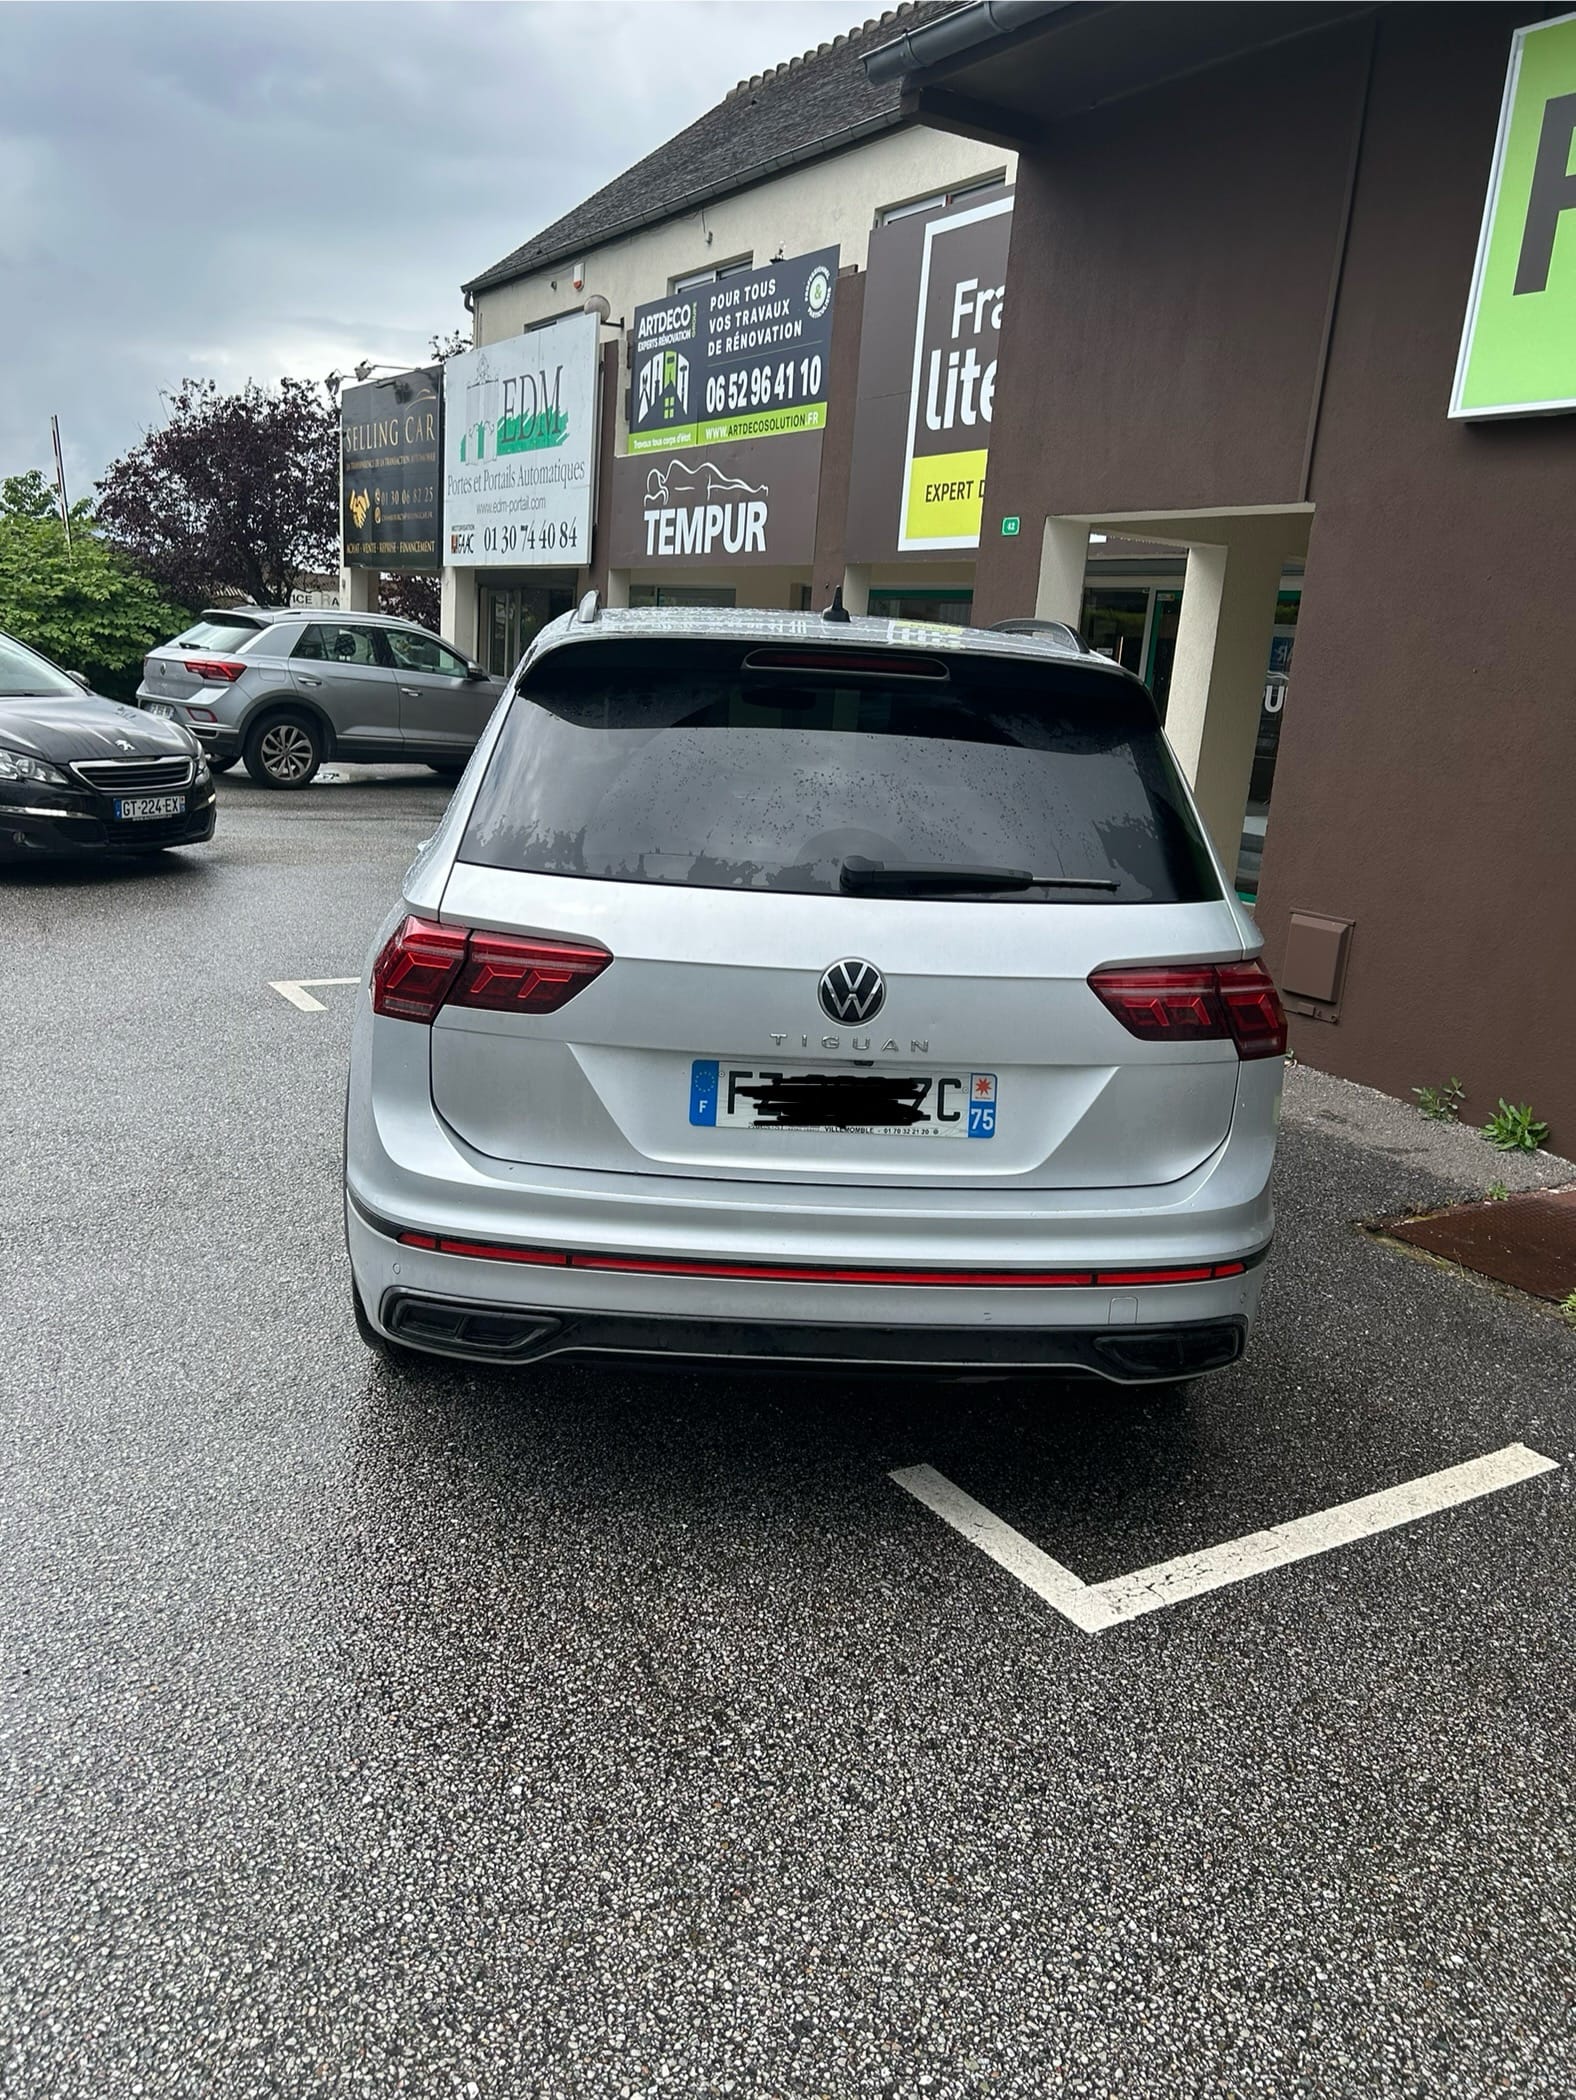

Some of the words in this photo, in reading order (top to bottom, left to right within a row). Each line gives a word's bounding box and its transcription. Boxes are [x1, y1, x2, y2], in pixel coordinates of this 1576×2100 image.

[710, 289, 740, 312] POUR
[744, 278, 776, 302] TOUS
[638, 304, 691, 339] ARTDECO
[709, 314, 731, 334] VOS
[735, 298, 790, 328] TRAVAUX
[637, 338, 658, 352] EXPERTS
[659, 329, 691, 346] RÉNOVATION
[708, 338, 722, 357] DE
[726, 319, 802, 353] RÉNOVATION
[706, 374, 725, 413] 06
[728, 370, 748, 410] 52
[750, 365, 772, 405] 96
[774, 360, 795, 400] 41
[800, 354, 822, 396] 10
[926, 347, 997, 431] lite
[501, 365, 563, 443] EDM
[344, 419, 398, 453] SELLING
[405, 413, 435, 443] CAR
[705, 411, 819, 441] WWW.ARTDECOSOLUTION.FR
[447, 474, 472, 496] Portes
[473, 474, 481, 492] et
[483, 464, 515, 491] Portails
[517, 458, 585, 489] Automatiques
[925, 480, 974, 503] EXPERT
[476, 496, 546, 515] www.edm-portail.com
[484, 526, 497, 551] 01
[501, 525, 517, 554] 30
[520, 519, 536, 552] 74
[539, 519, 555, 550] 40
[559, 516, 578, 548] 84
[643, 500, 768, 556] TEMPUR
[399, 540, 435, 553] FINANCEMENT
[123, 797, 179, 816] GT-224-EX
[769, 1032, 929, 1054] TIGUAN
[698, 1100, 707, 1113] F
[971, 1108, 994, 1130] 75
